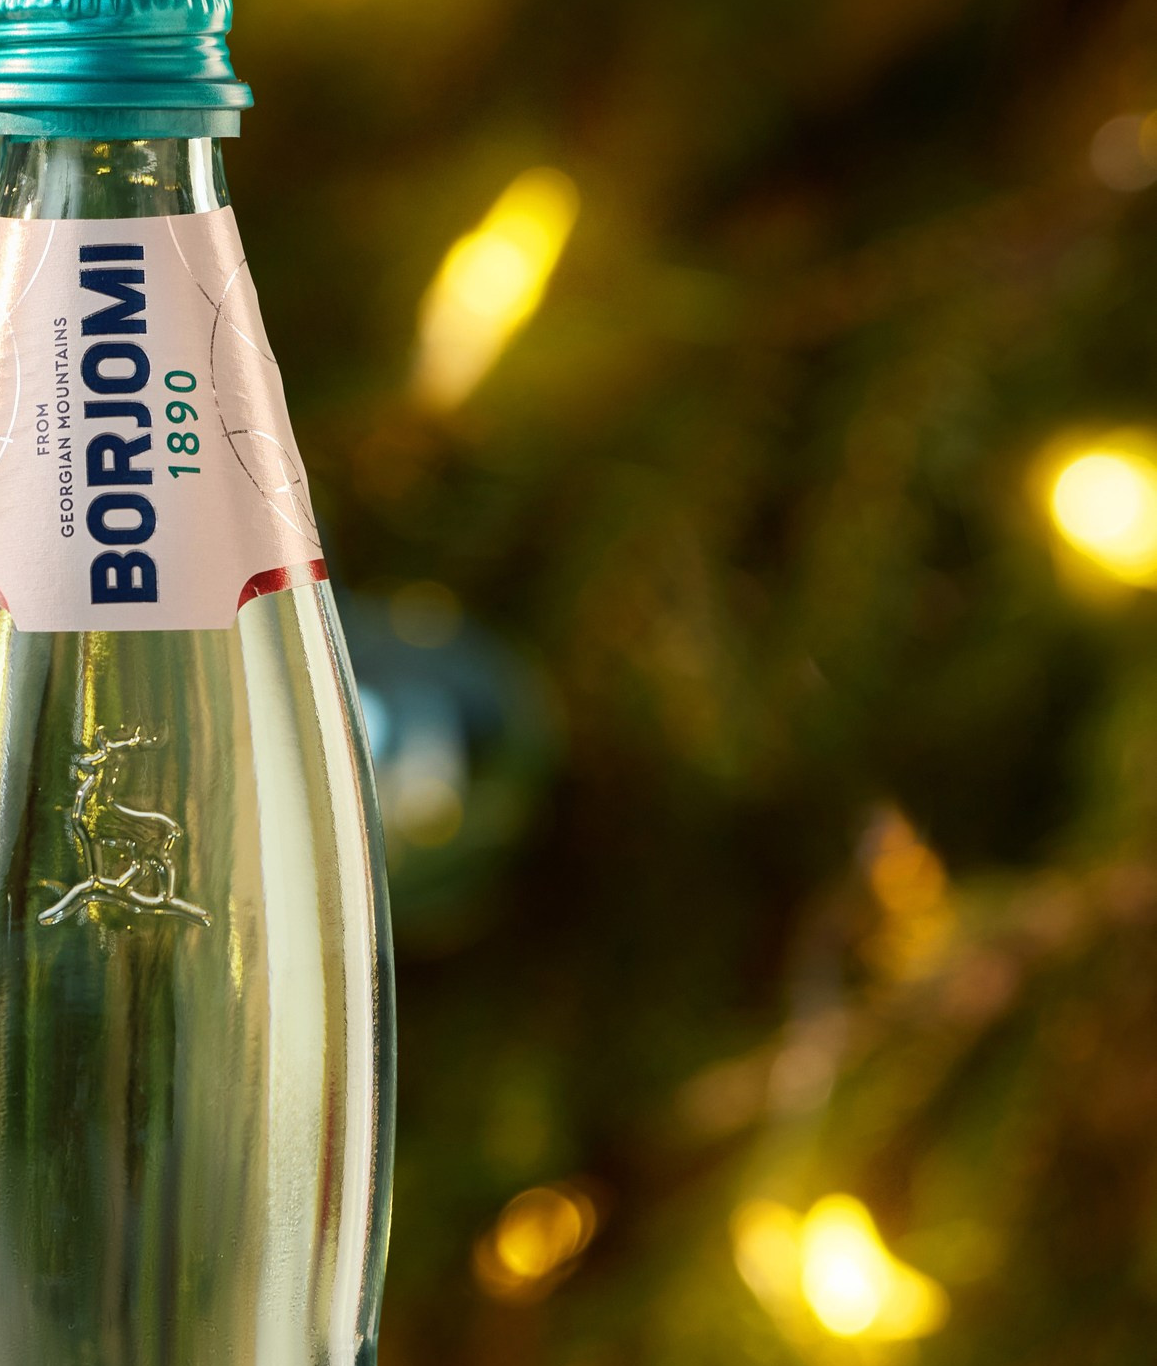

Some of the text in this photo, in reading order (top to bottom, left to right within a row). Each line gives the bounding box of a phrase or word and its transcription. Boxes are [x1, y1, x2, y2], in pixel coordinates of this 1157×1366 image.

[37, 403, 49, 456] FROM
[54, 316, 74, 538] GEORGIAN MOUNTAINS
[79, 243, 159, 605] BORJOMI
[165, 370, 201, 480] 1890
